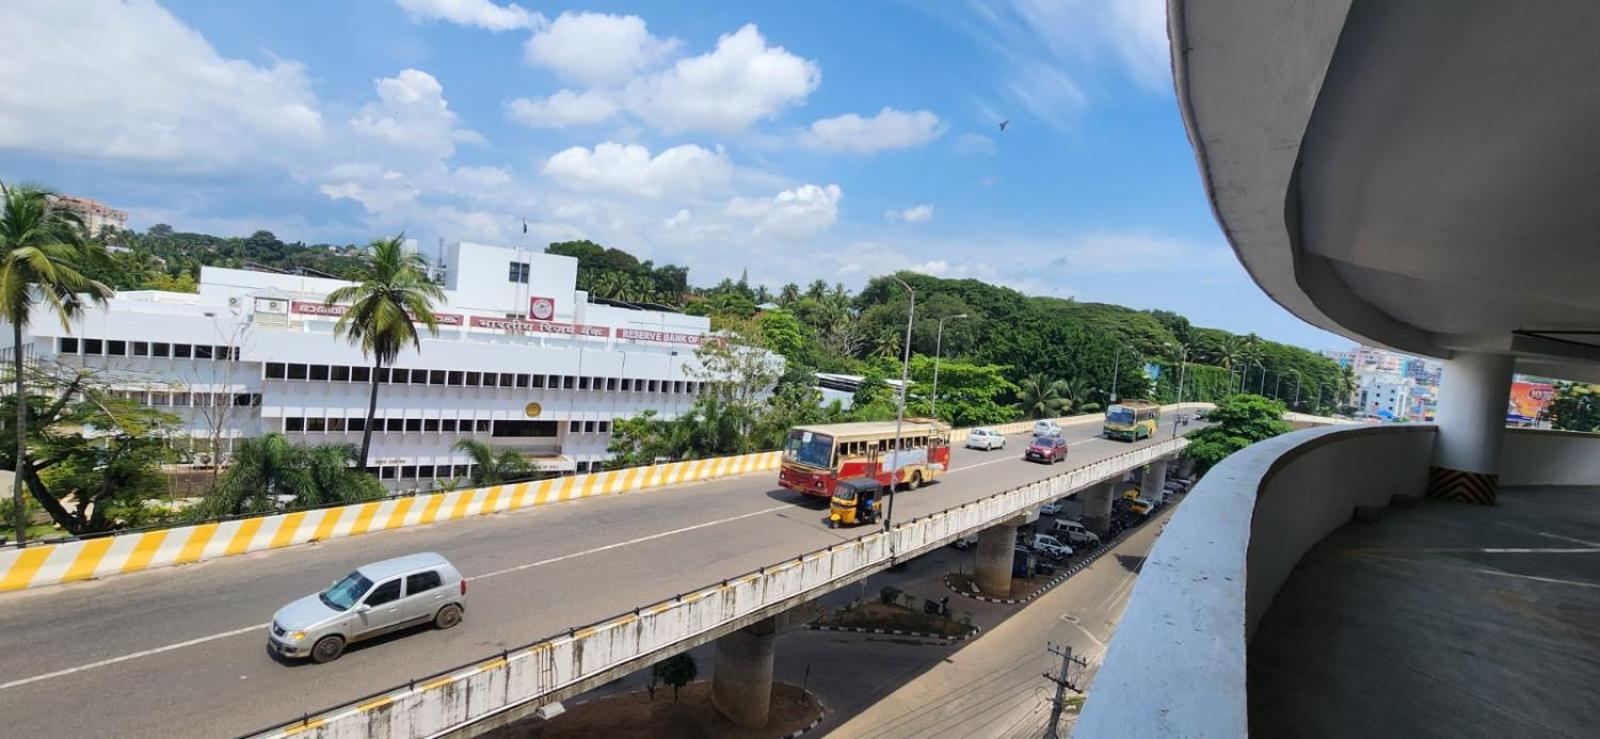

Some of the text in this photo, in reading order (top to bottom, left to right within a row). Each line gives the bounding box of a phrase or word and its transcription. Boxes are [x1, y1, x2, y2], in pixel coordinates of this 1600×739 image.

[479, 319, 534, 331] भारतीय
[623, 328, 662, 341] RESERVE
[663, 332, 687, 342] BANK
[688, 335, 699, 343] OF
